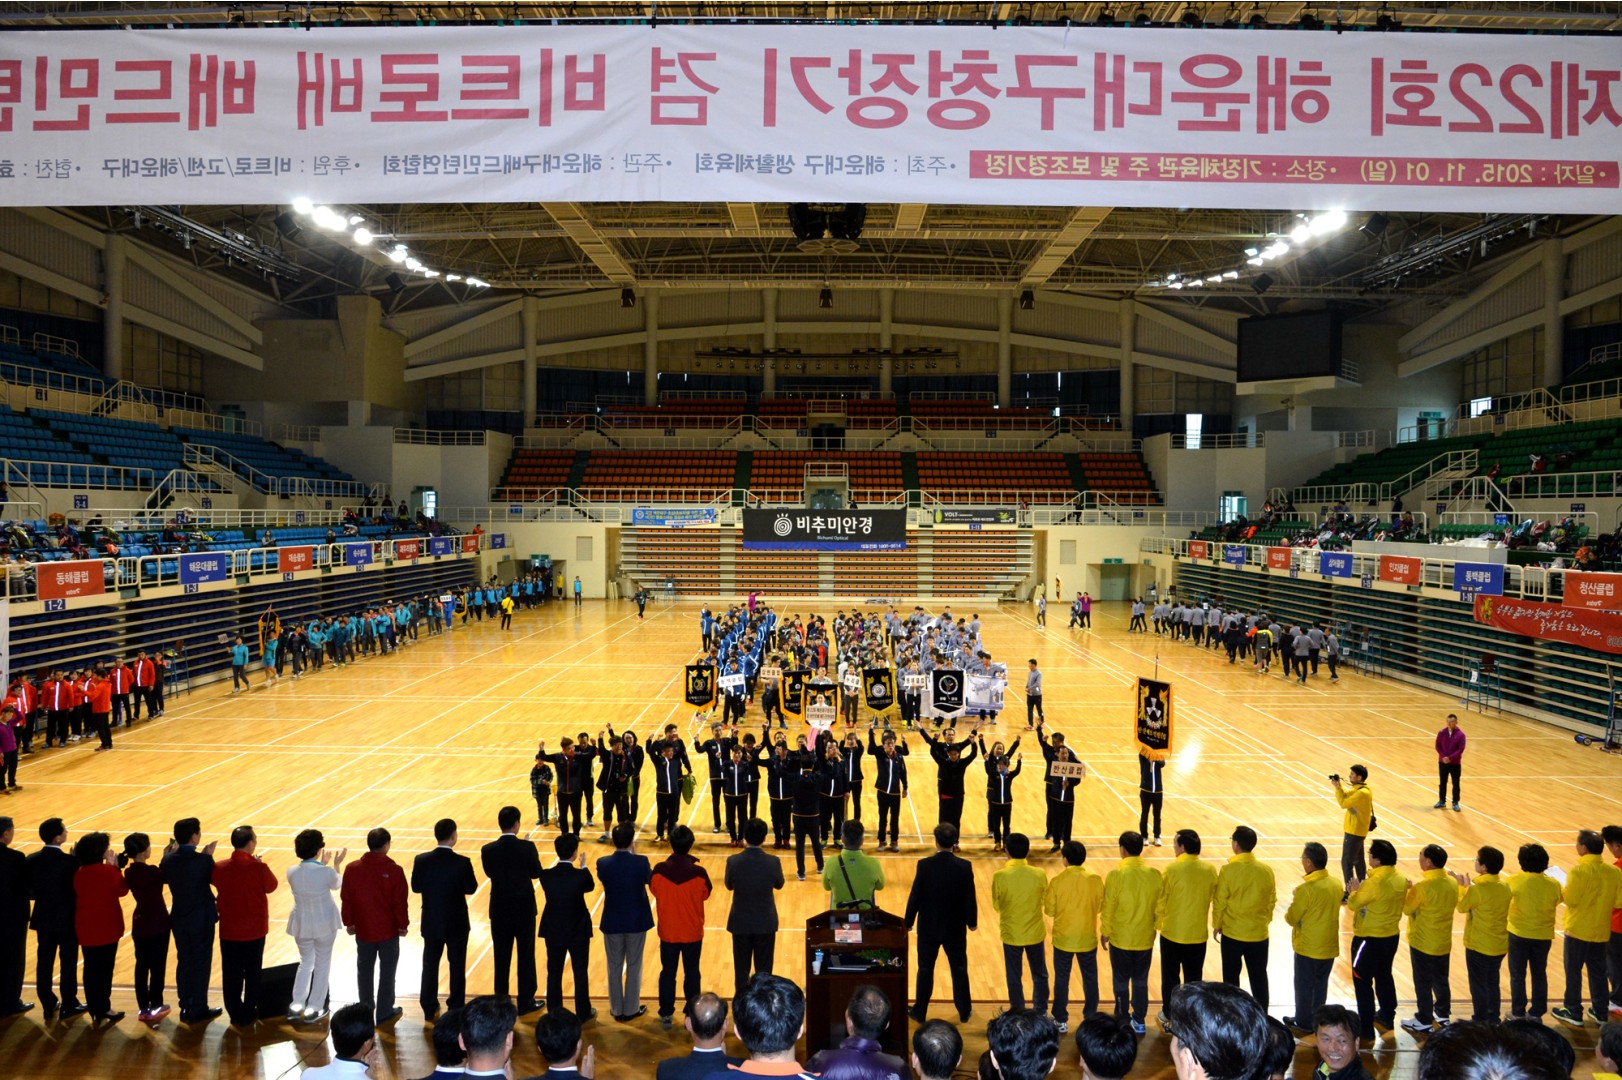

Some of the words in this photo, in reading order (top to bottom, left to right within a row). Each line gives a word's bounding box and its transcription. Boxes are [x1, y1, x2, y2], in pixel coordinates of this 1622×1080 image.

[796, 516, 873, 534] 비추미안경
[189, 560, 218, 572] 해운대클럽
[56, 570, 89, 585] 동해클럽
[1465, 570, 1491, 583] 동백클럽
[1580, 581, 1614, 596] 청산클럽
[48, 600, 63, 610] 1-2
